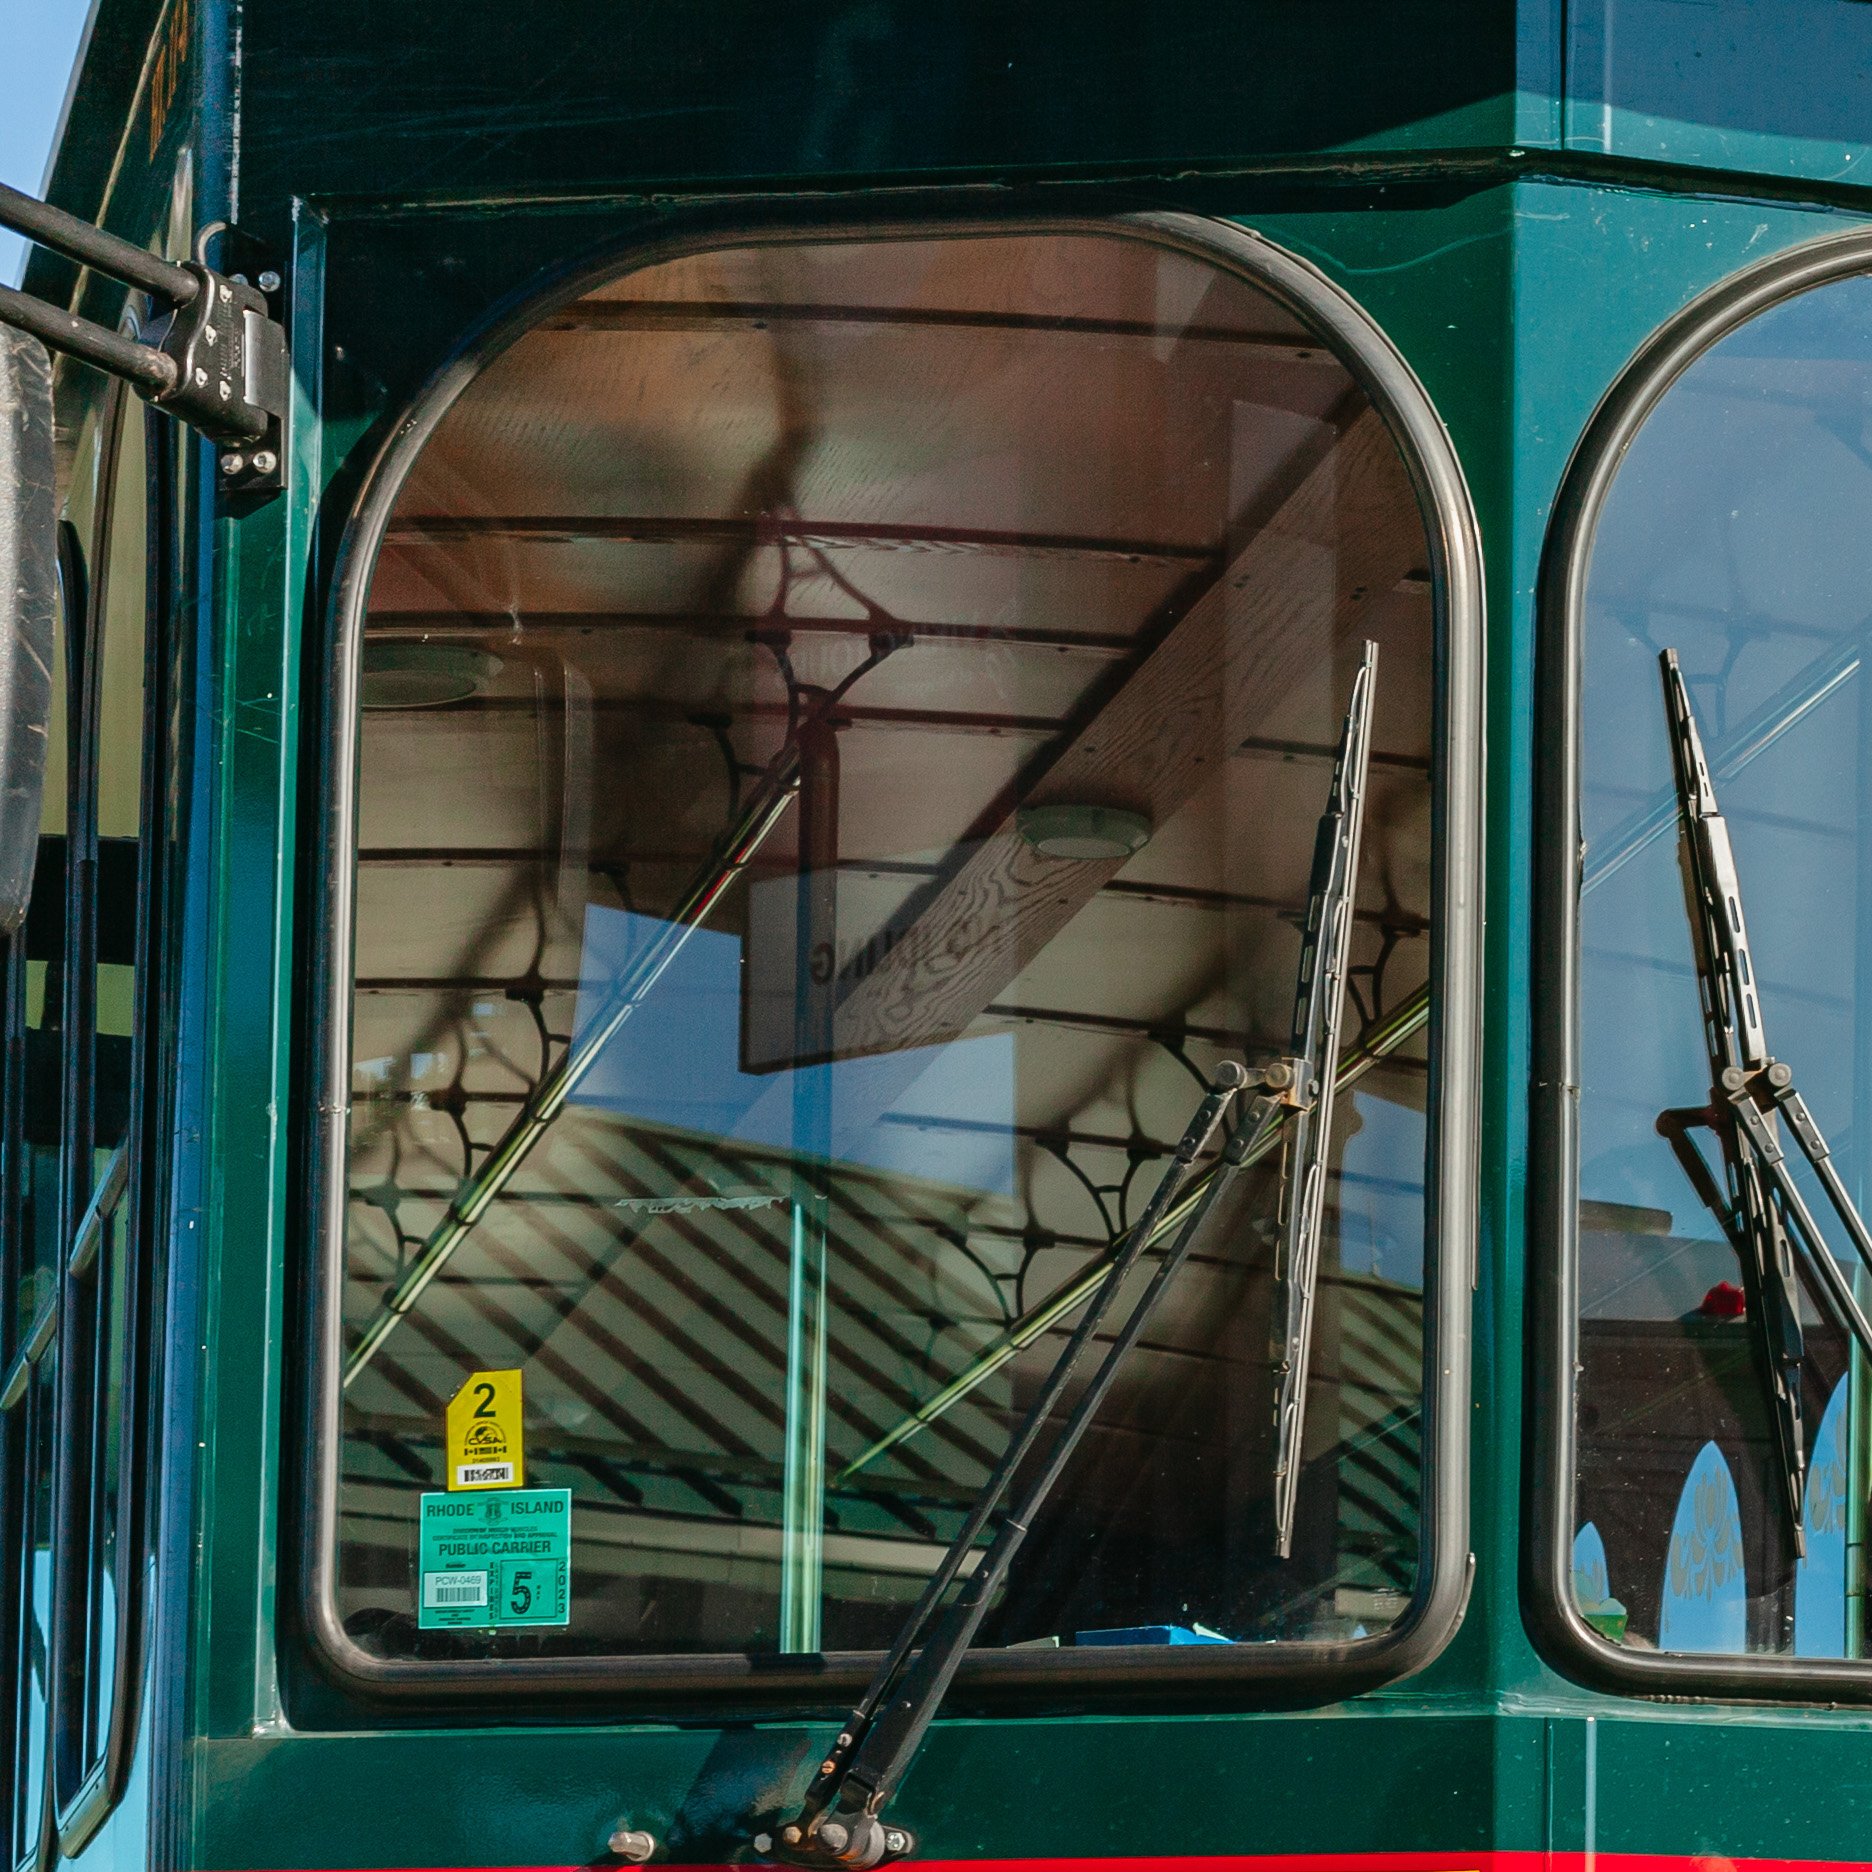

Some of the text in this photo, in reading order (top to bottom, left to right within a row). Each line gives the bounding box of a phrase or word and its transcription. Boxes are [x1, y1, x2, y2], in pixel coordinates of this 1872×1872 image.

[473, 1382, 497, 1419] 2
[426, 1500, 564, 1517] RHODE ISLAND
[438, 1540, 551, 1557] PUBLIC CARRIER
[435, 1576, 482, 1586] PCW-0469
[510, 1571, 532, 1615] 5
[557, 1561, 566, 1614] 2023
